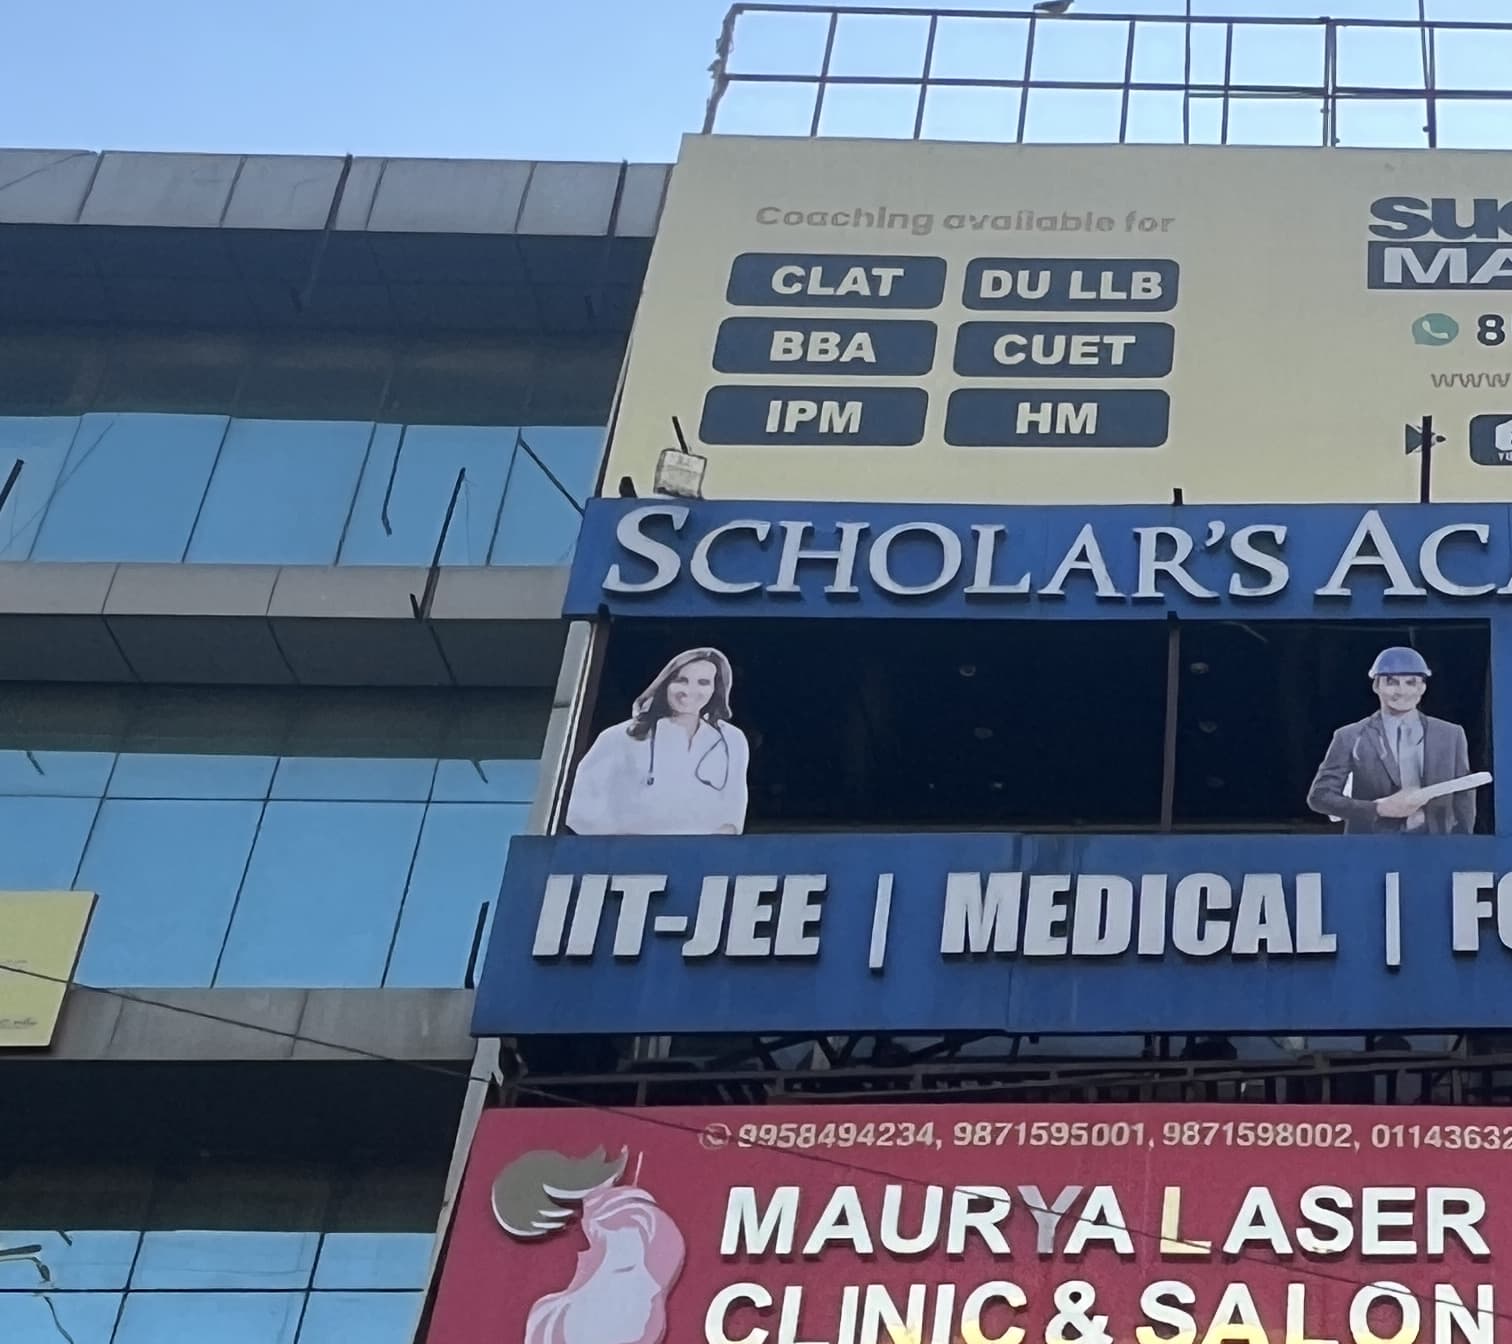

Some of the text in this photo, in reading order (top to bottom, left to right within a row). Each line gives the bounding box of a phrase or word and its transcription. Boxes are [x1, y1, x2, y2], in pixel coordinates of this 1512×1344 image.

[756, 206, 1176, 236] Coaching available for
[771, 265, 904, 297] CLAT
[980, 269, 1163, 300] DU LLB
[770, 330, 876, 363] BBA
[994, 333, 1136, 366] CUET
[765, 400, 863, 434] IPM
[1016, 402, 1098, 435] HM
[603, 506, 1289, 599] SCHOLAR'S
[532, 873, 827, 957] IIT-JEE
[941, 871, 1337, 956] MEDICAL
[738, 1122, 943, 1149] 9958494234,
[952, 1122, 1155, 1149] 9871595001,
[1163, 1122, 1360, 1151] 9871598002,
[720, 1186, 1491, 1256] MAURYA LASER
